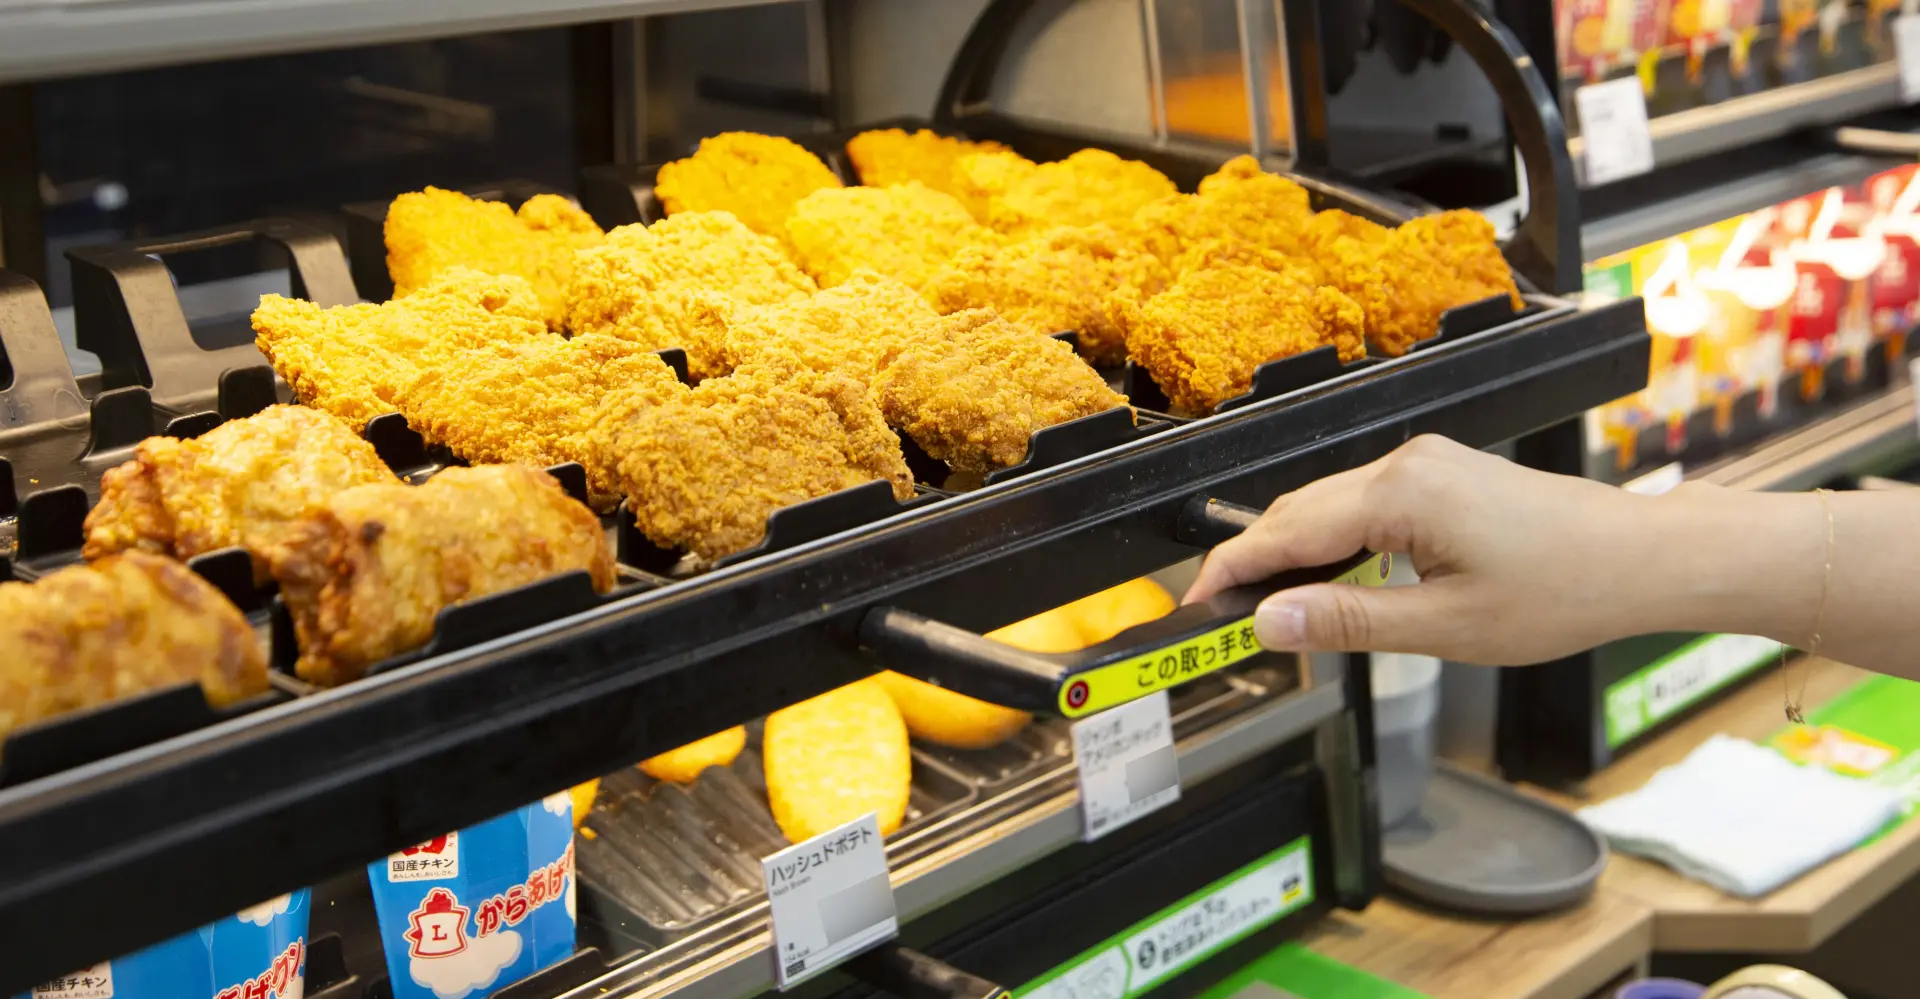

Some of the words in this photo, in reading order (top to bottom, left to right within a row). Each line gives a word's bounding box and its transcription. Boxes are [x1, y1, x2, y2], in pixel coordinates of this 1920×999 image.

[1137, 626, 1254, 688] この取っ手を
[392, 859, 454, 872] 国産チキン
[771, 826, 872, 886] ハッシュドポテト
[432, 924, 448, 941] L
